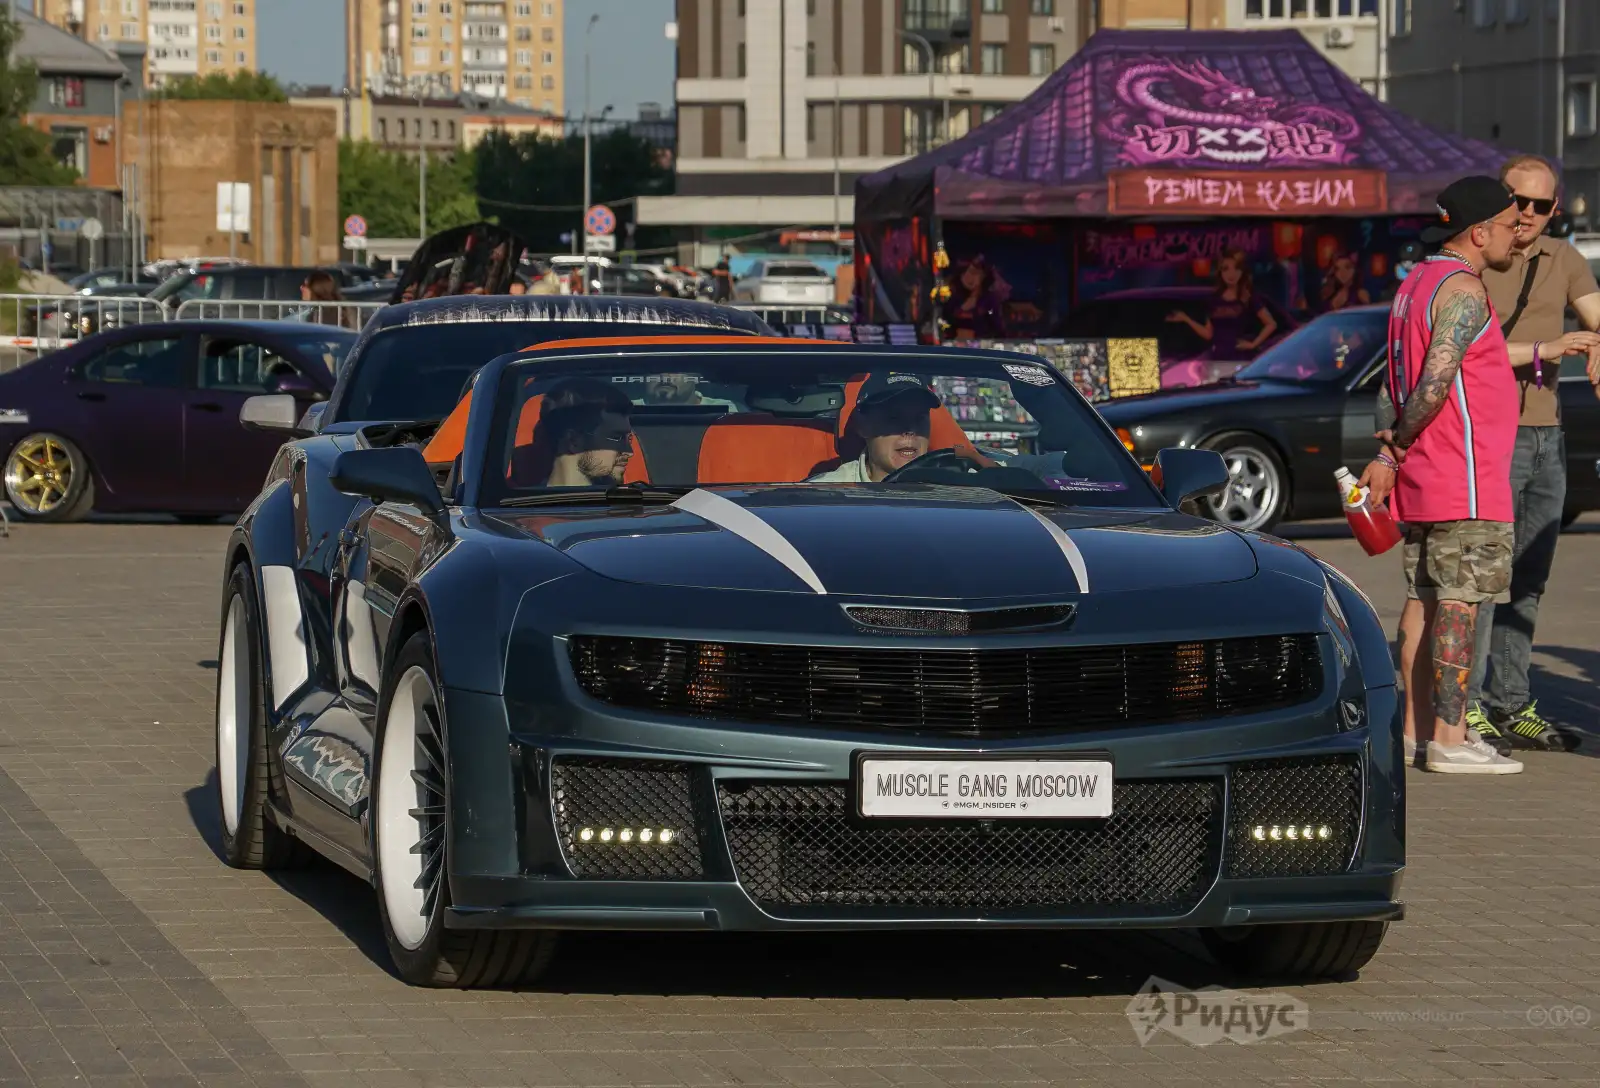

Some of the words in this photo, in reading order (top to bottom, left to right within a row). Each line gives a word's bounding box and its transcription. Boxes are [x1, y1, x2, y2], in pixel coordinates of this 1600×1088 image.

[1144, 176, 1245, 207] РЕЖЕМ
[1255, 177, 1356, 211] КЛЕИМ
[876, 773, 949, 797] MUSCLE
[958, 774, 1008, 798] GANG
[1016, 774, 1099, 798] MOSCOW
[953, 802, 1016, 810] @MGM_INSIDER
